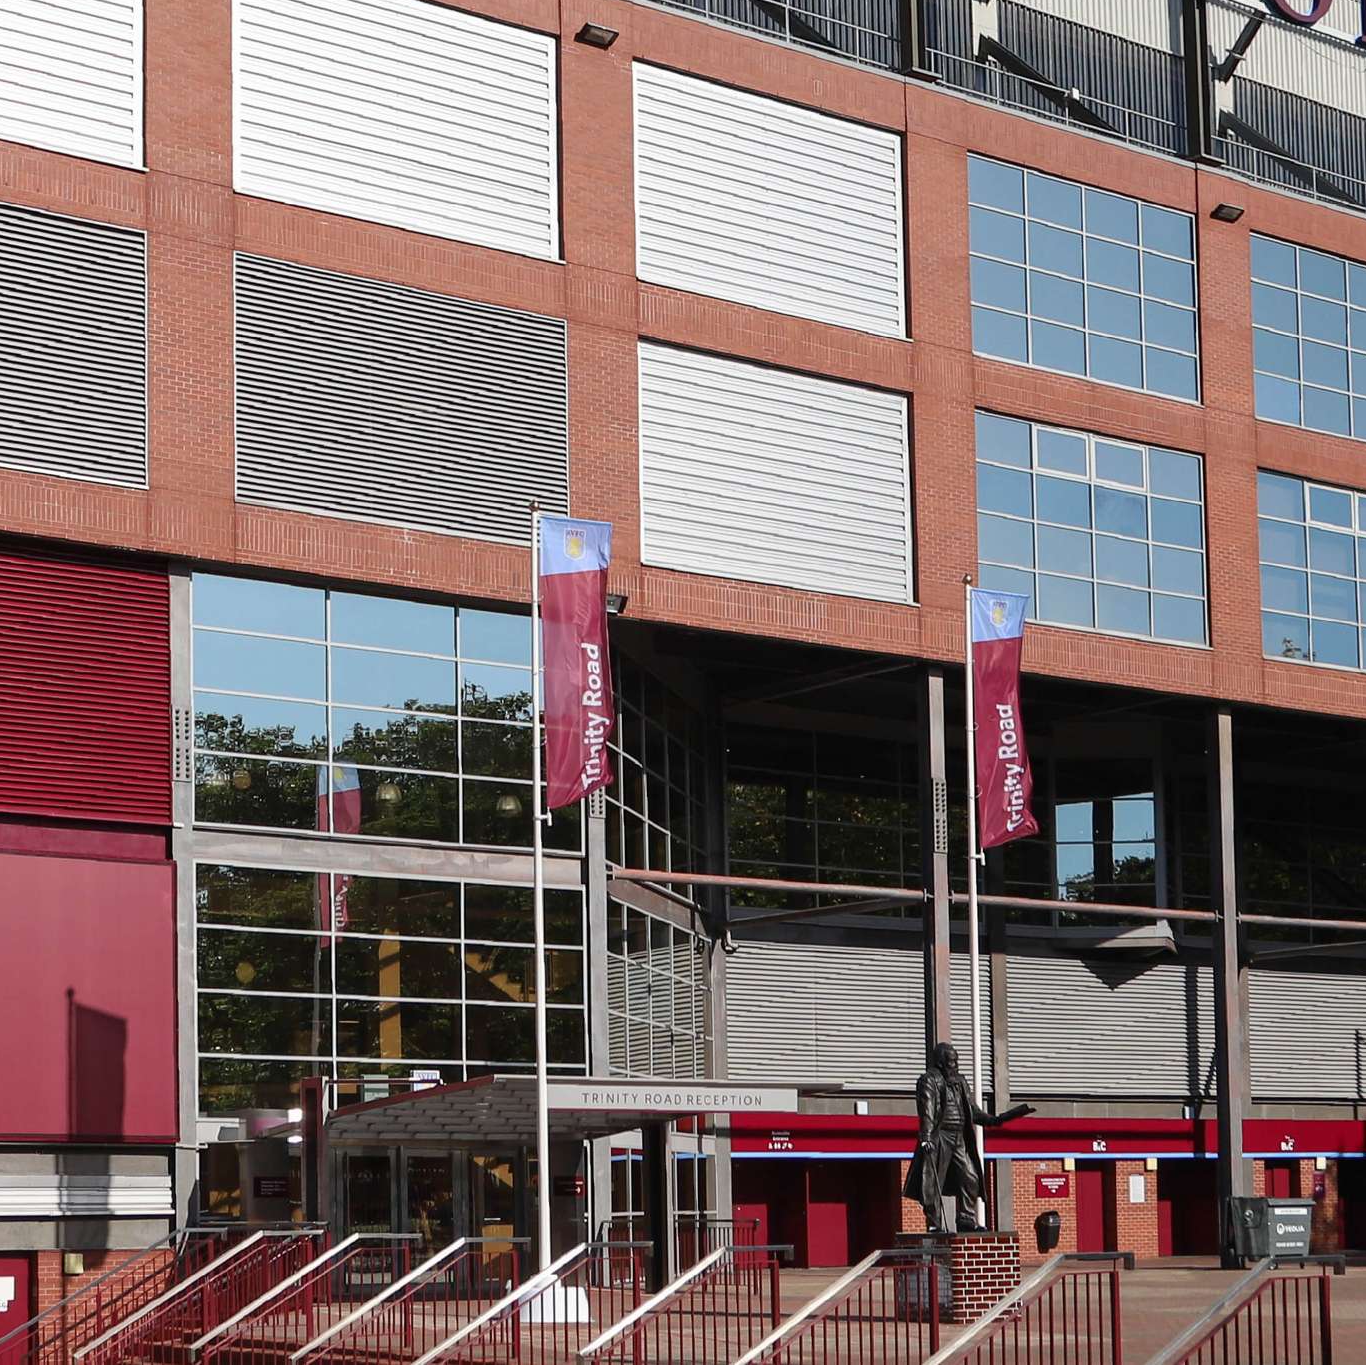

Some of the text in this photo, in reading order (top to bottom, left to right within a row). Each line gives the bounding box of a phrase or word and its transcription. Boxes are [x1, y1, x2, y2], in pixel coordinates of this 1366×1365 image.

[581, 642, 611, 792] Trinity Road
[996, 703, 1025, 832] Trinity Road
[581, 1092, 763, 1107] TRINITY ROAD RECEPTION
